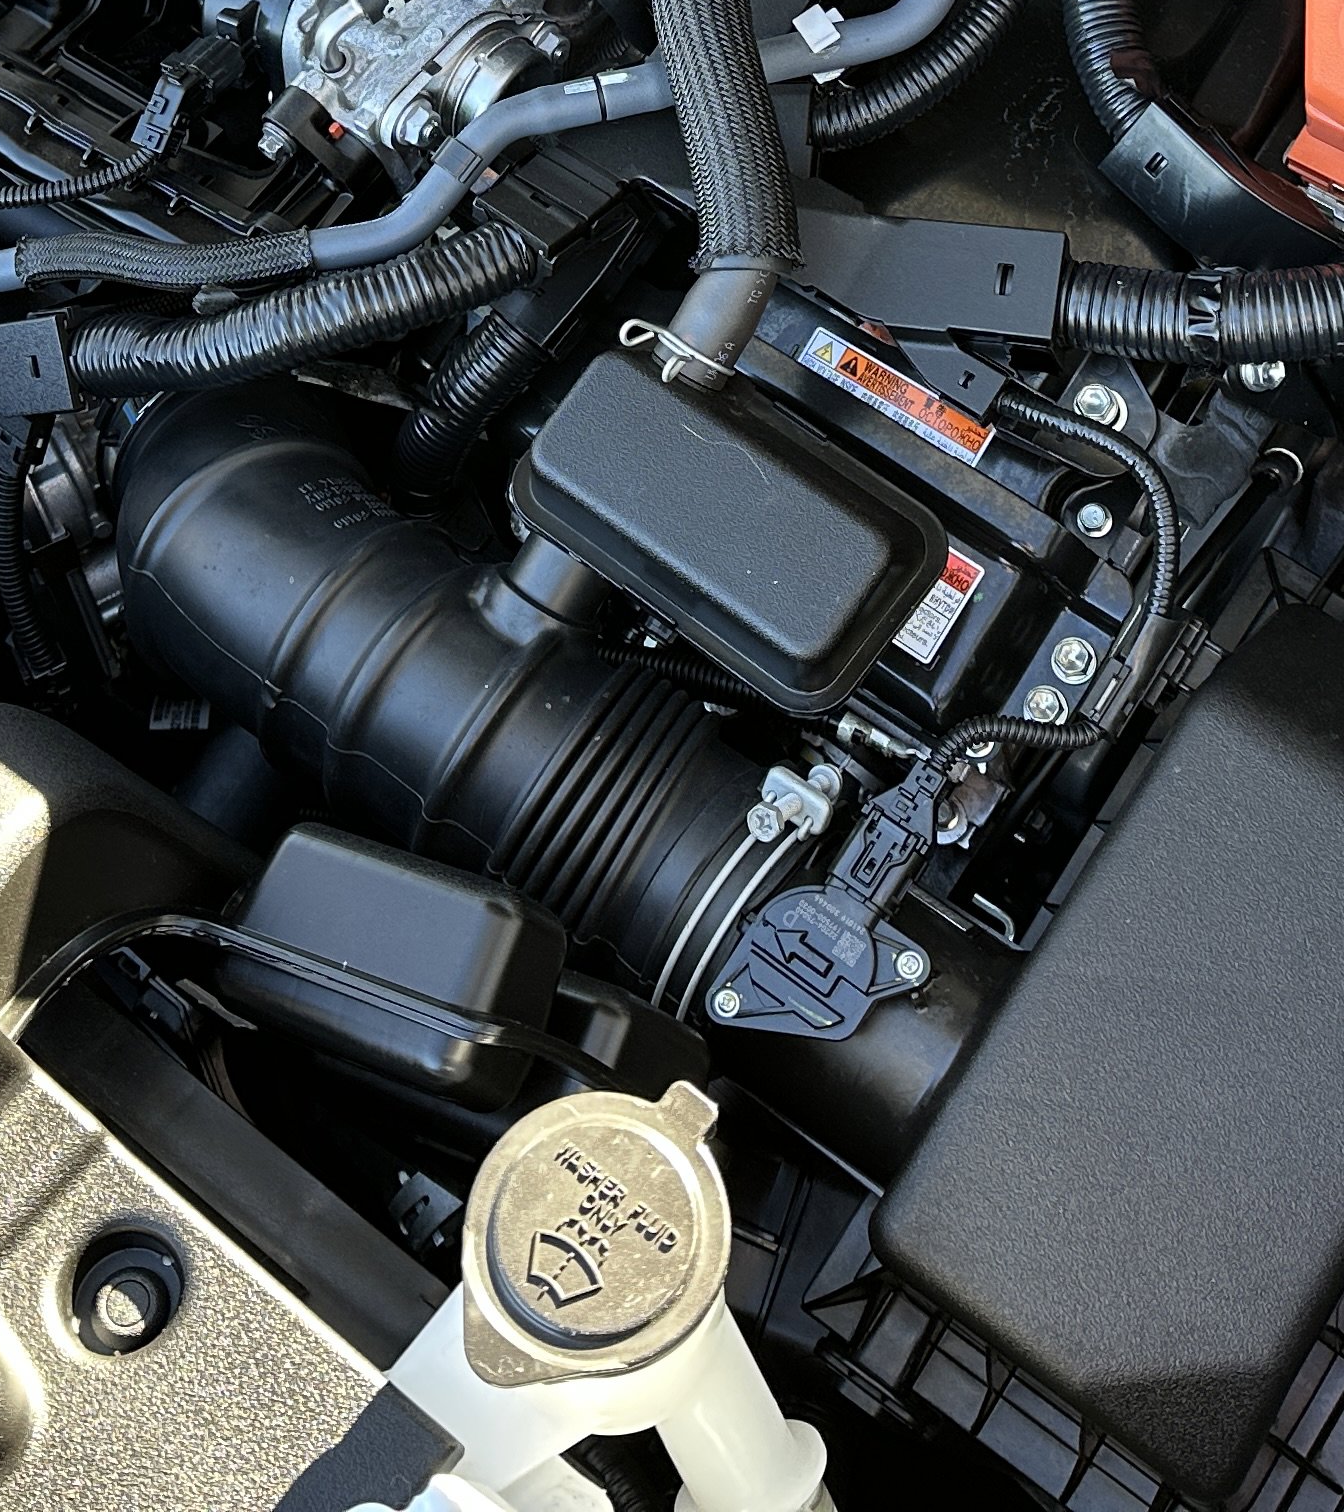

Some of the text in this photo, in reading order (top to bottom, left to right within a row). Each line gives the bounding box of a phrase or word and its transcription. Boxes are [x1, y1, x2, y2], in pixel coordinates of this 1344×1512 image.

[856, 372, 914, 411] AVERTISSEMENT
[862, 361, 910, 394] WARNING
[916, 408, 982, 451] ОСТОРОЖНО
[553, 1139, 679, 1254] WASHER FLUID
[578, 1192, 628, 1236] ONLY
